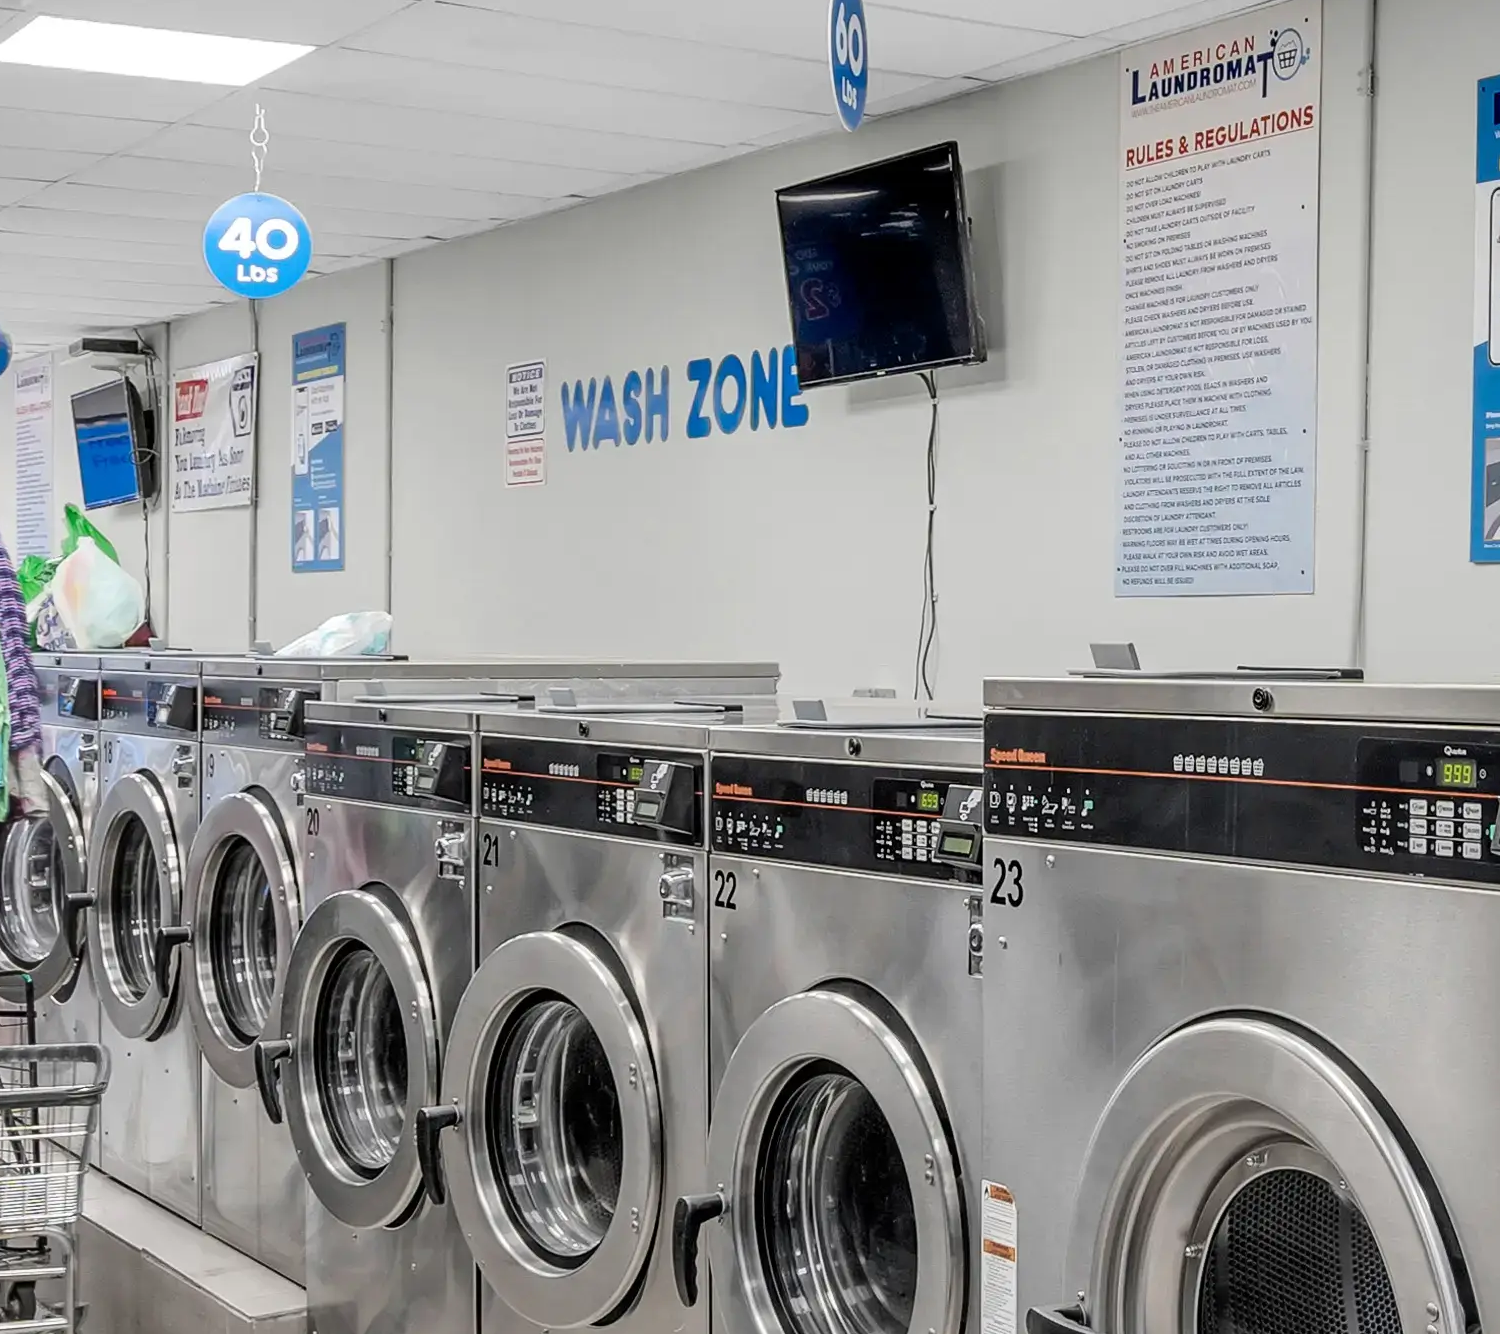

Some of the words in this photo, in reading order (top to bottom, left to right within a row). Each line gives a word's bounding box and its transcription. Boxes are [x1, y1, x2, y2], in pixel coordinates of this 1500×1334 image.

[836, 2, 863, 77] 60
[1150, 35, 1256, 79] AMERICAN
[841, 76, 858, 111] Lbs
[1132, 51, 1273, 105] LAUNDROMAT
[1126, 139, 1174, 167] RULES
[1178, 137, 1188, 155] &
[1194, 105, 1314, 151] REGULATIONS
[218, 217, 298, 260] 40
[237, 264, 278, 284] Lbs
[511, 369, 540, 382] NOTICE
[561, 365, 669, 453] WASH
[686, 344, 809, 439] ZONE
[104, 740, 113, 763] 18
[989, 747, 1017, 765] Speed
[1018, 748, 1046, 764] Queen
[307, 807, 320, 837] 20
[483, 833, 499, 868] 21
[714, 869, 737, 911] 22
[990, 857, 1024, 908] 23
